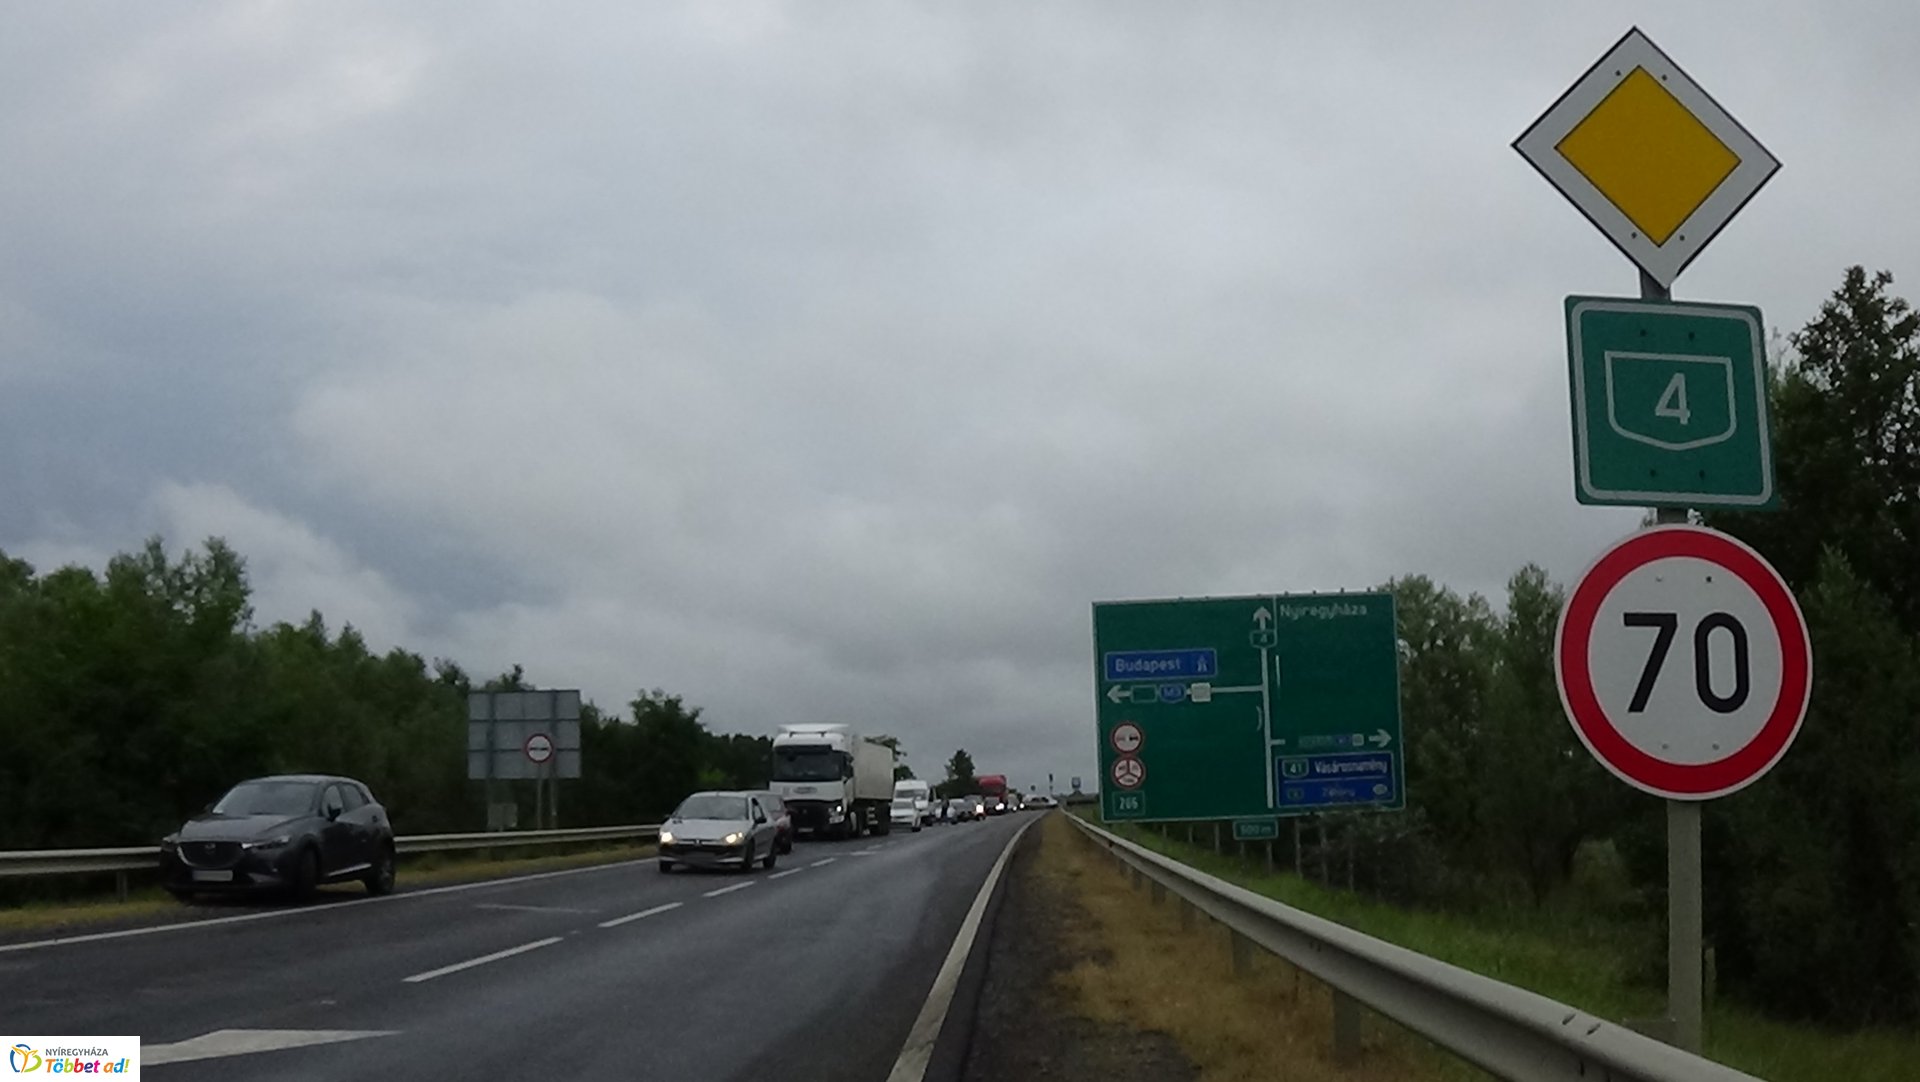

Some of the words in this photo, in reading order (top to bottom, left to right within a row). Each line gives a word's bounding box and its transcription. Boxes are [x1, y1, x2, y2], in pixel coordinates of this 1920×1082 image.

[1654, 372, 1691, 425] 4
[1115, 657, 1182, 674] Budapest
[1623, 612, 1750, 714] 70
[1290, 762, 1303, 774] 41
